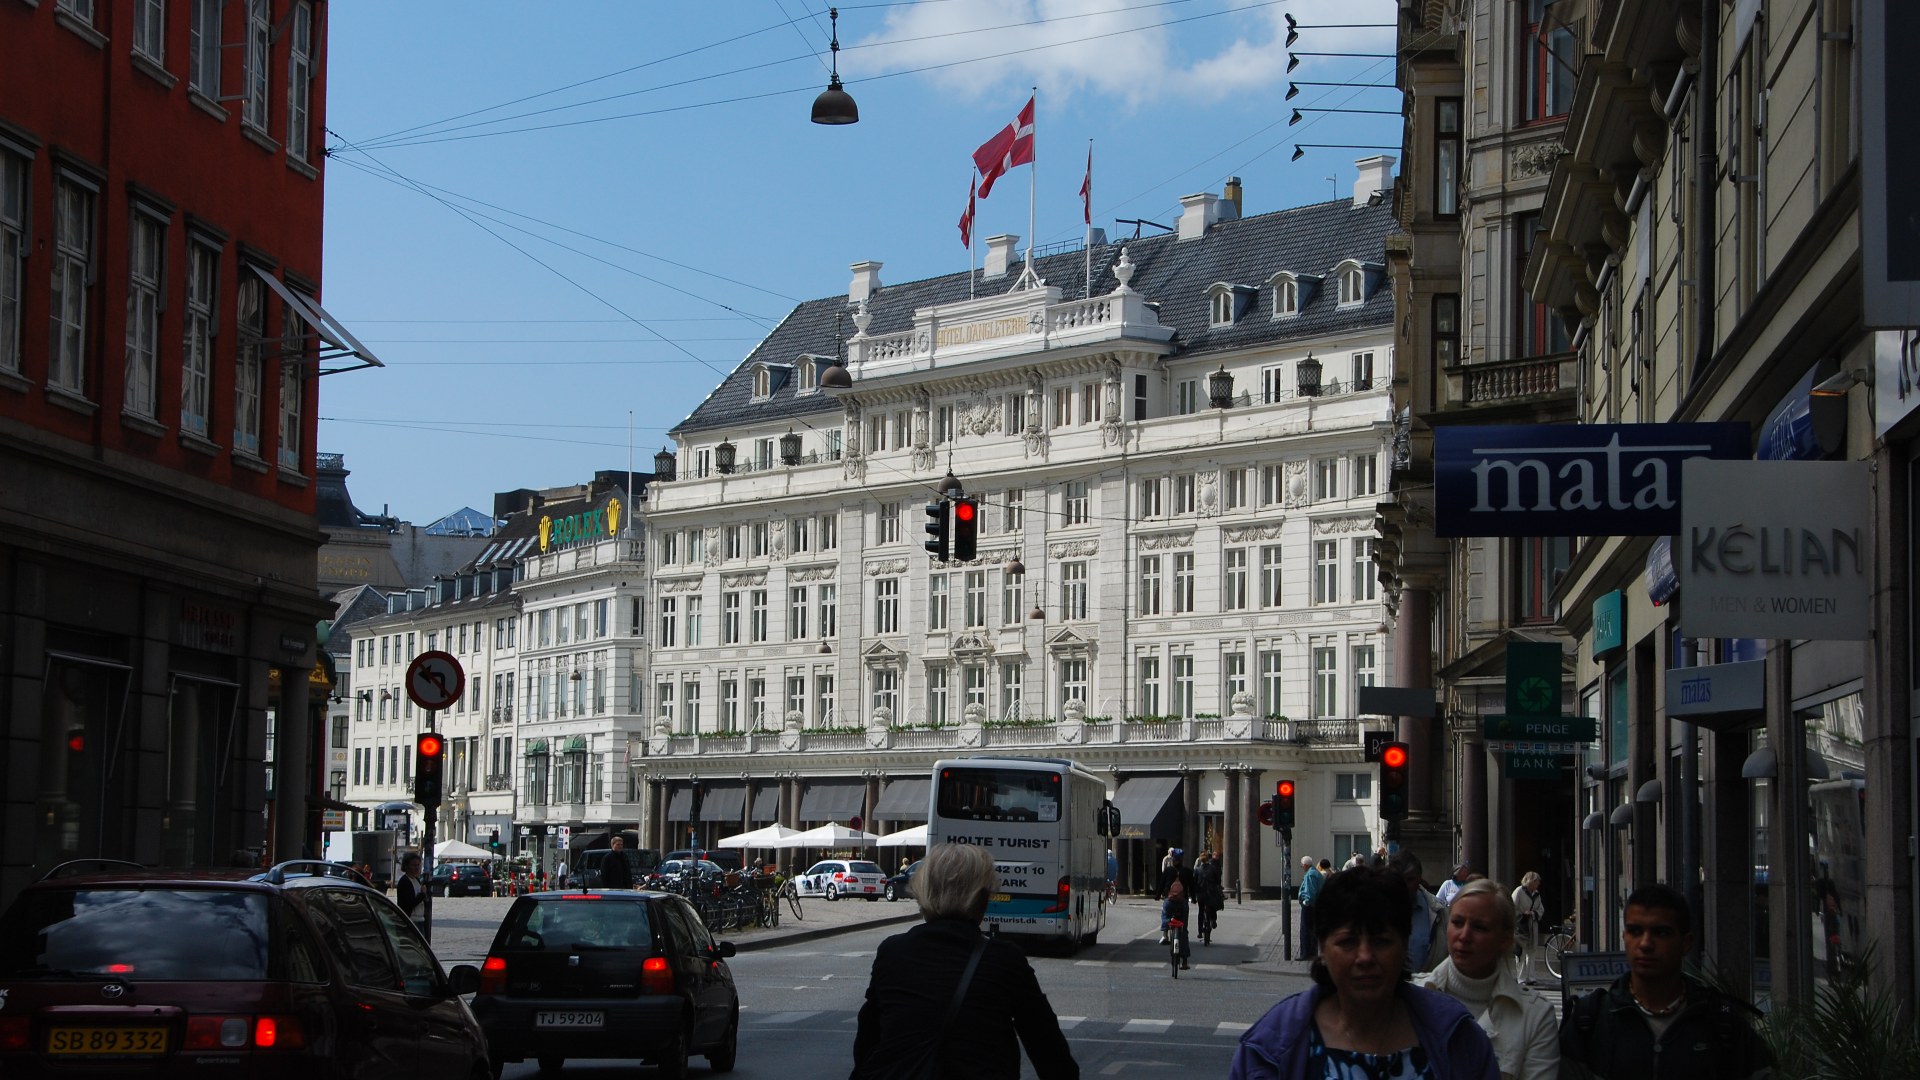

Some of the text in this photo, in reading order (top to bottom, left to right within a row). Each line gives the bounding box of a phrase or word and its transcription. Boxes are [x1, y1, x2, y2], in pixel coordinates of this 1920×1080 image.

[1469, 431, 1712, 512] mata
[553, 509, 604, 545] ROLEX
[1691, 524, 1863, 575] KÉLIAN
[1711, 597, 1836, 614] MEN & WOMEN
[1681, 675, 1712, 705] matas
[1526, 723, 1569, 735] PENGE
[1513, 758, 1555, 769] BANK
[947, 835, 1050, 849] HOLTE TURIST
[1014, 866, 1028, 874] 01
[1032, 867, 1045, 875] 10
[1000, 878, 1027, 888] ARK
[983, 916, 1037, 925] olteturist.dk
[539, 1013, 555, 1025] TJ
[54, 1031, 84, 1050] SB
